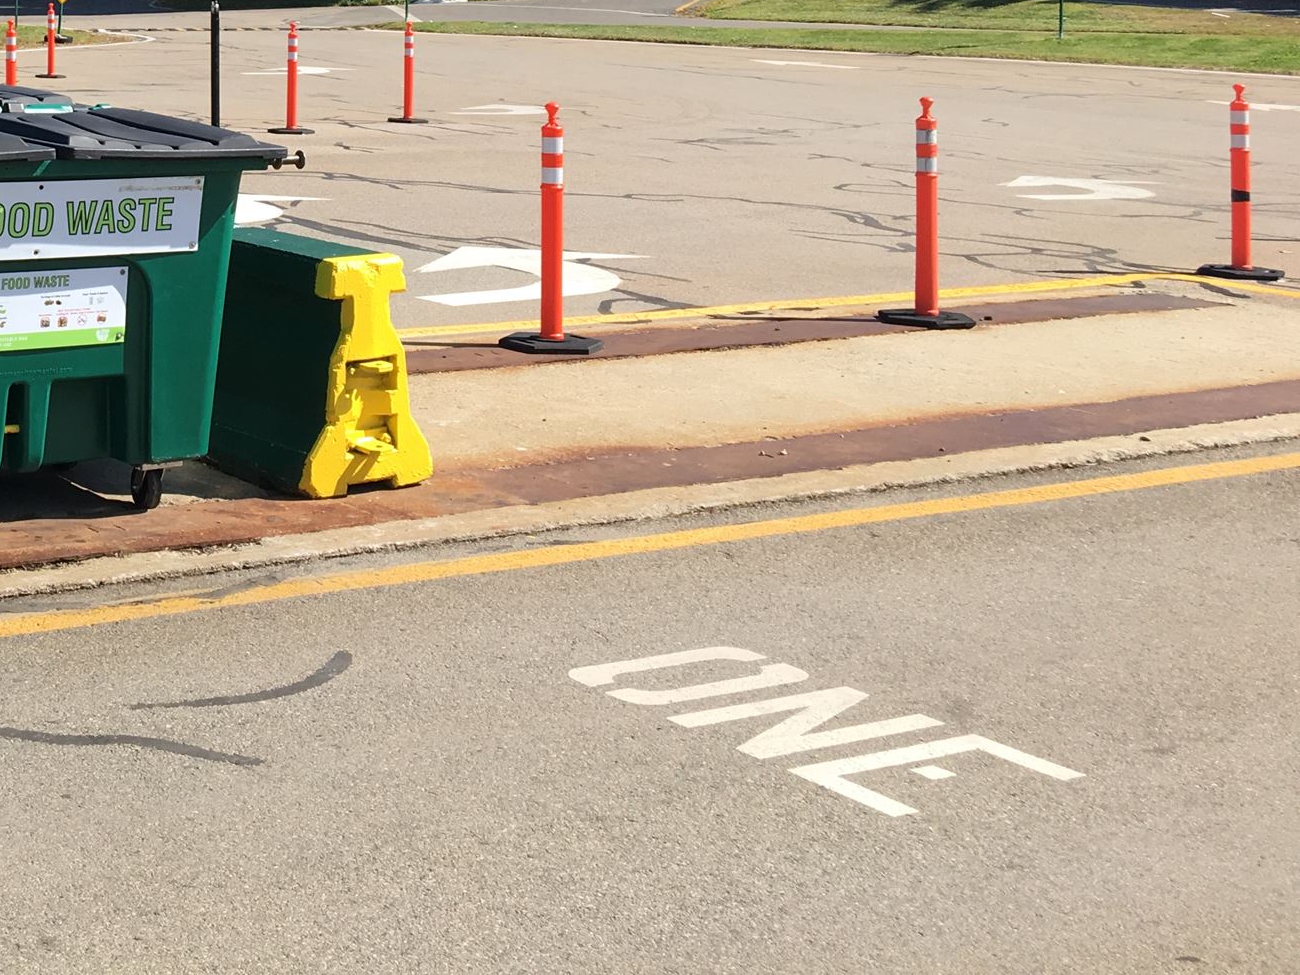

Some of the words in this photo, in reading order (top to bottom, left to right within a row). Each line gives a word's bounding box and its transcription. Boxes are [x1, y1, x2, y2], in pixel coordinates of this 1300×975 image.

[66, 196, 176, 236] WASTE
[1, 276, 31, 291] FOOD
[33, 274, 71, 289] WASTE
[568, 645, 1087, 818] ONE
